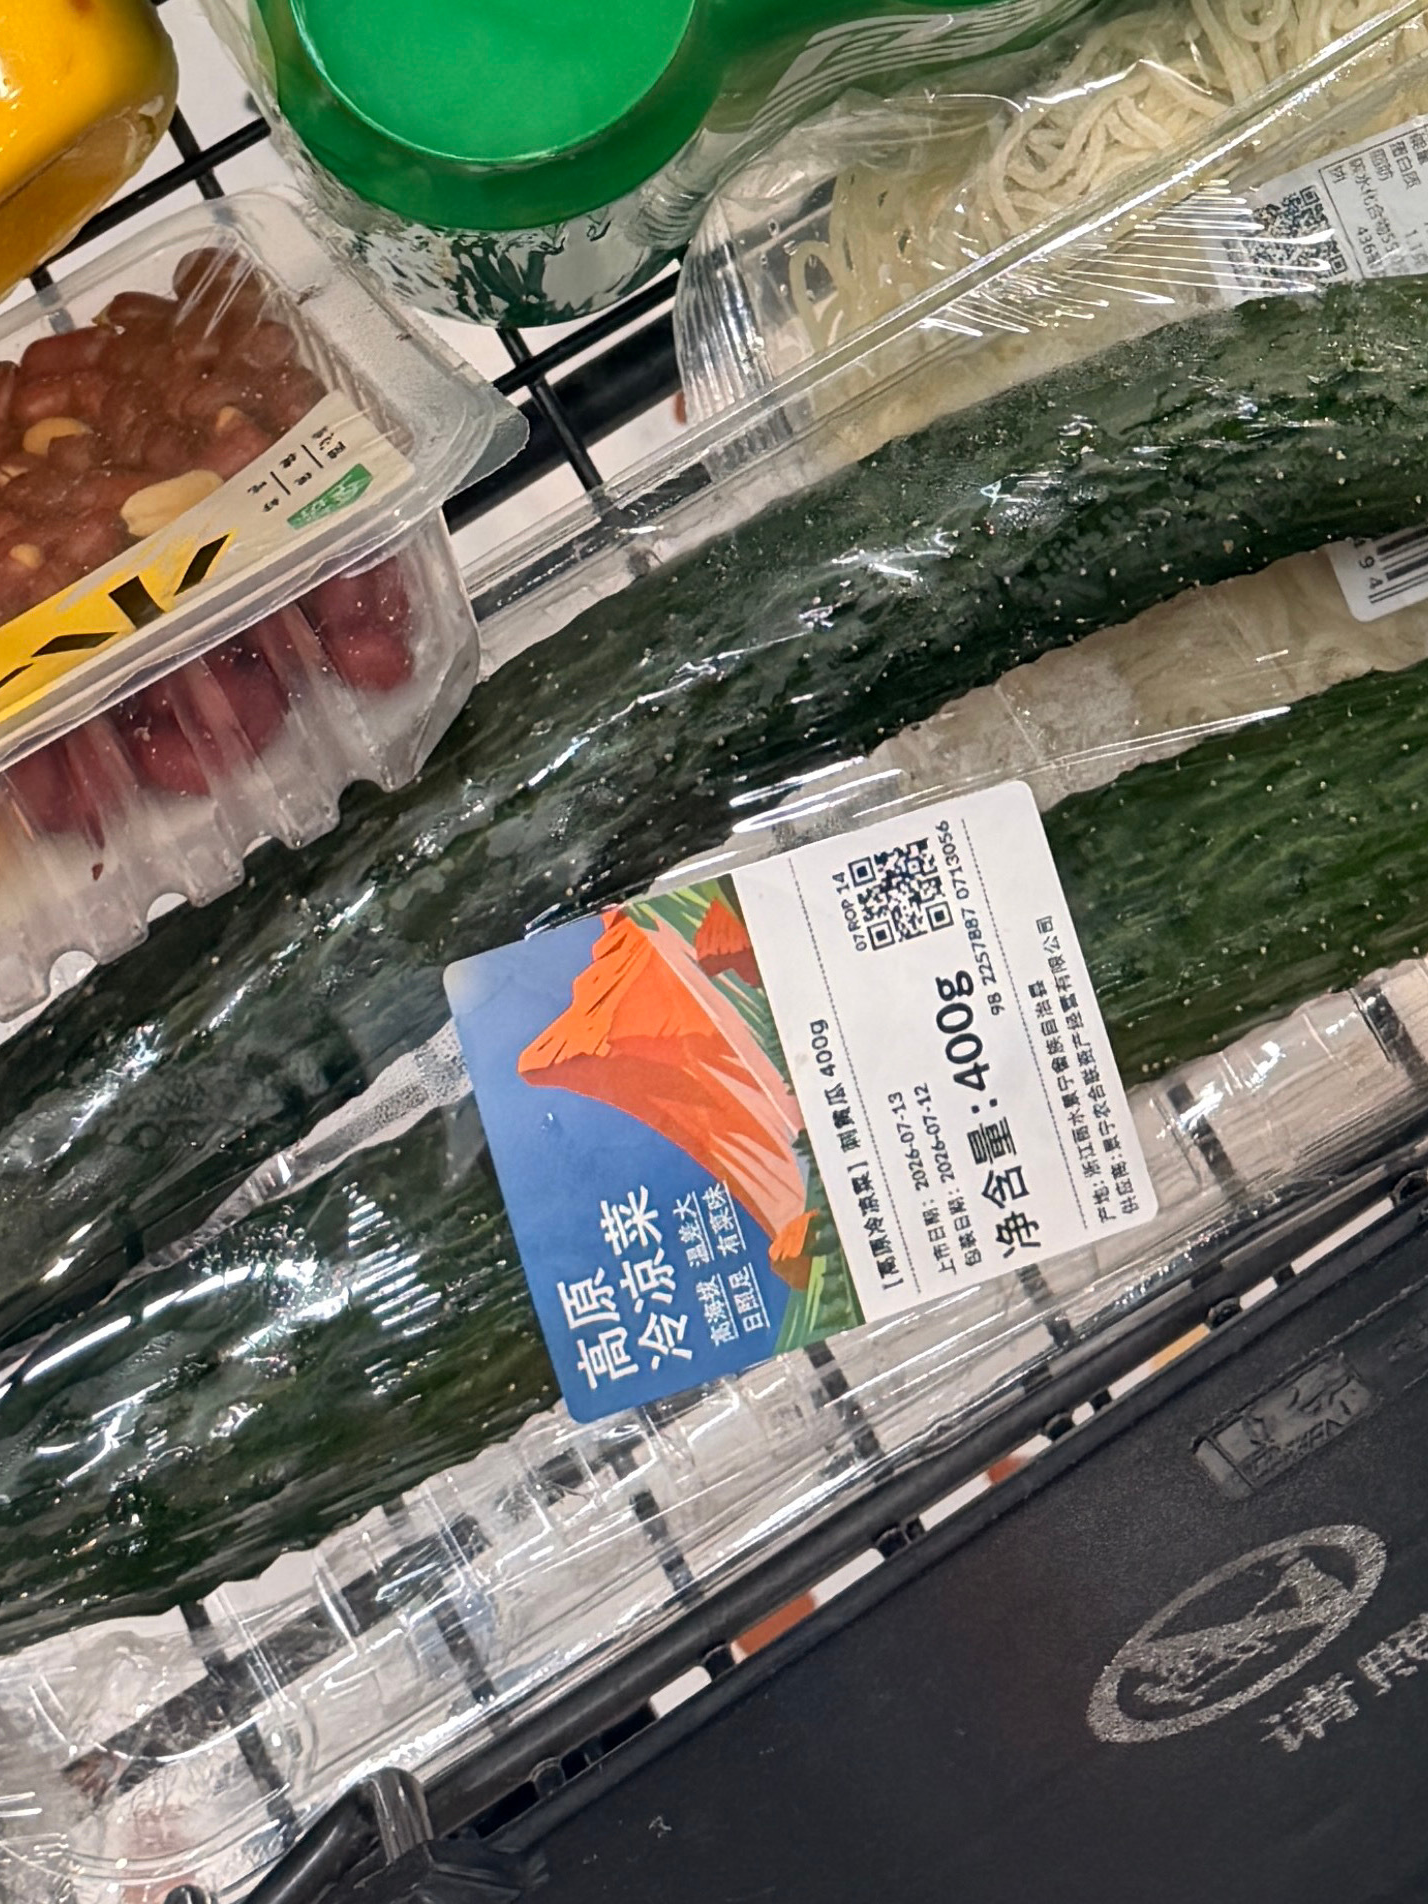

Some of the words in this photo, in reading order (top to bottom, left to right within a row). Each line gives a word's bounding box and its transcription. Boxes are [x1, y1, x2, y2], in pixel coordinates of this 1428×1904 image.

[831, 871, 850, 895] 14
[936, 821, 969, 900] 0713056
[961, 908, 997, 986] 2257887
[988, 992, 1005, 1015] 98
[809, 1019, 840, 1078] 400g
[673, 1193, 707, 1268] 温差大
[599, 1185, 692, 1371] 冷凉菜
[696, 1275, 734, 1346] 高海拔
[728, 1265, 764, 1332] 日照足
[561, 1267, 638, 1390] 高原
